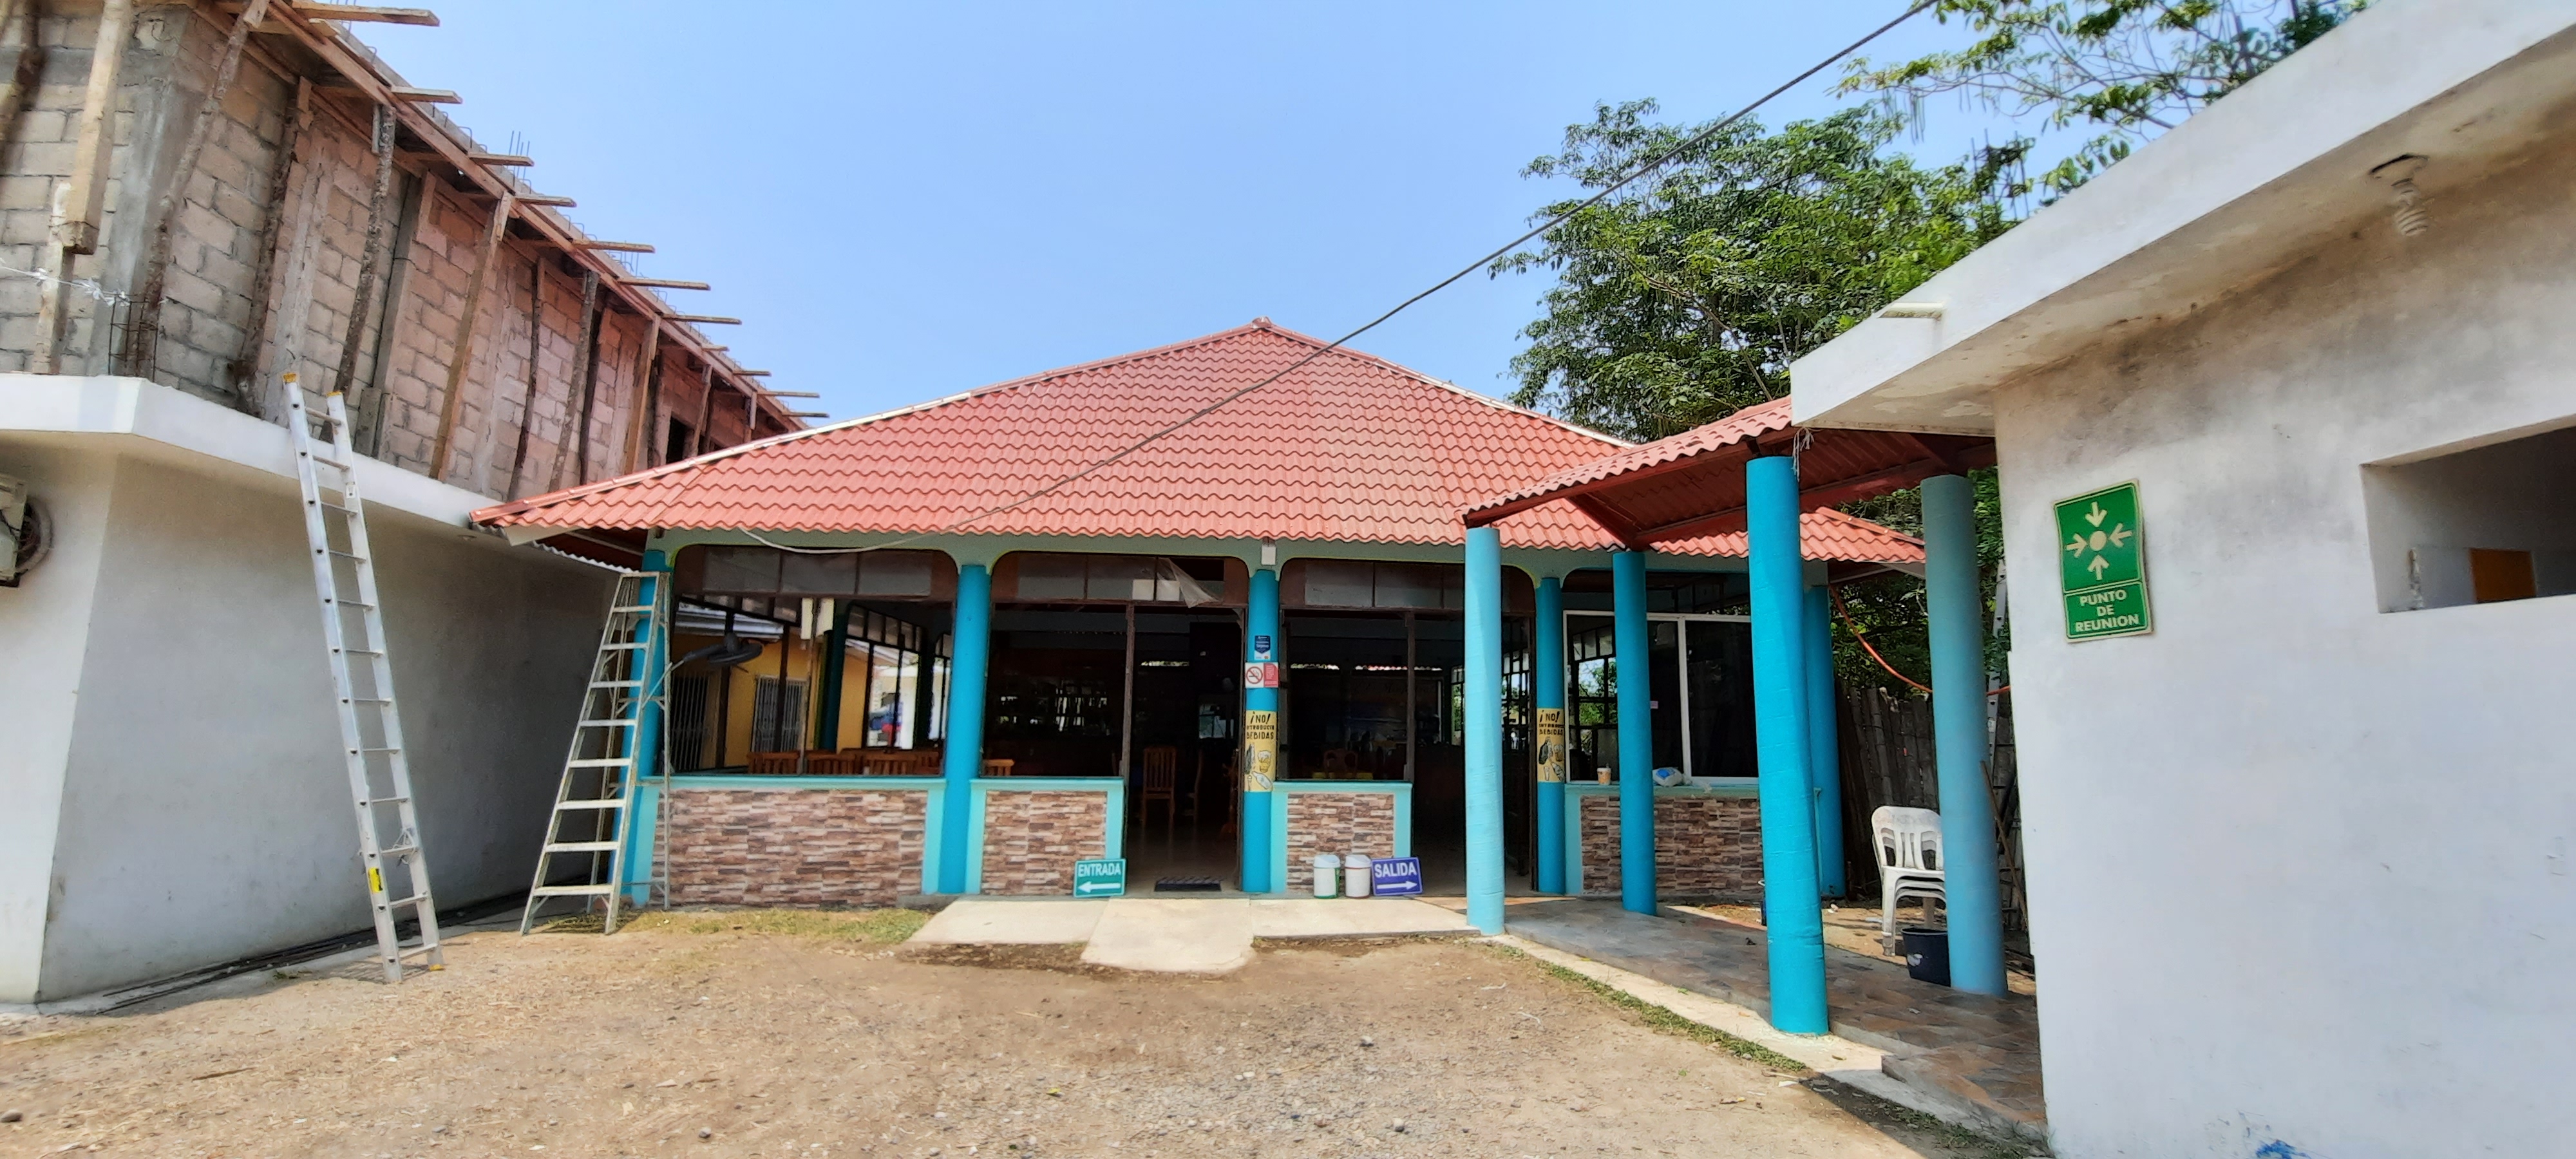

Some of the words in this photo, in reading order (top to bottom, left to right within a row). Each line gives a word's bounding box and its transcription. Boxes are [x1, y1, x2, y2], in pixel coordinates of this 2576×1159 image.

[2079, 589, 2127, 607] PUNTO
[2096, 604, 2114, 617] DE
[2075, 614, 2139, 632] REUNION
[1247, 731, 1274, 740] BEBIDAS
[1077, 863, 1121, 877] ENTRADA
[1374, 862, 1417, 878] SALIDA
